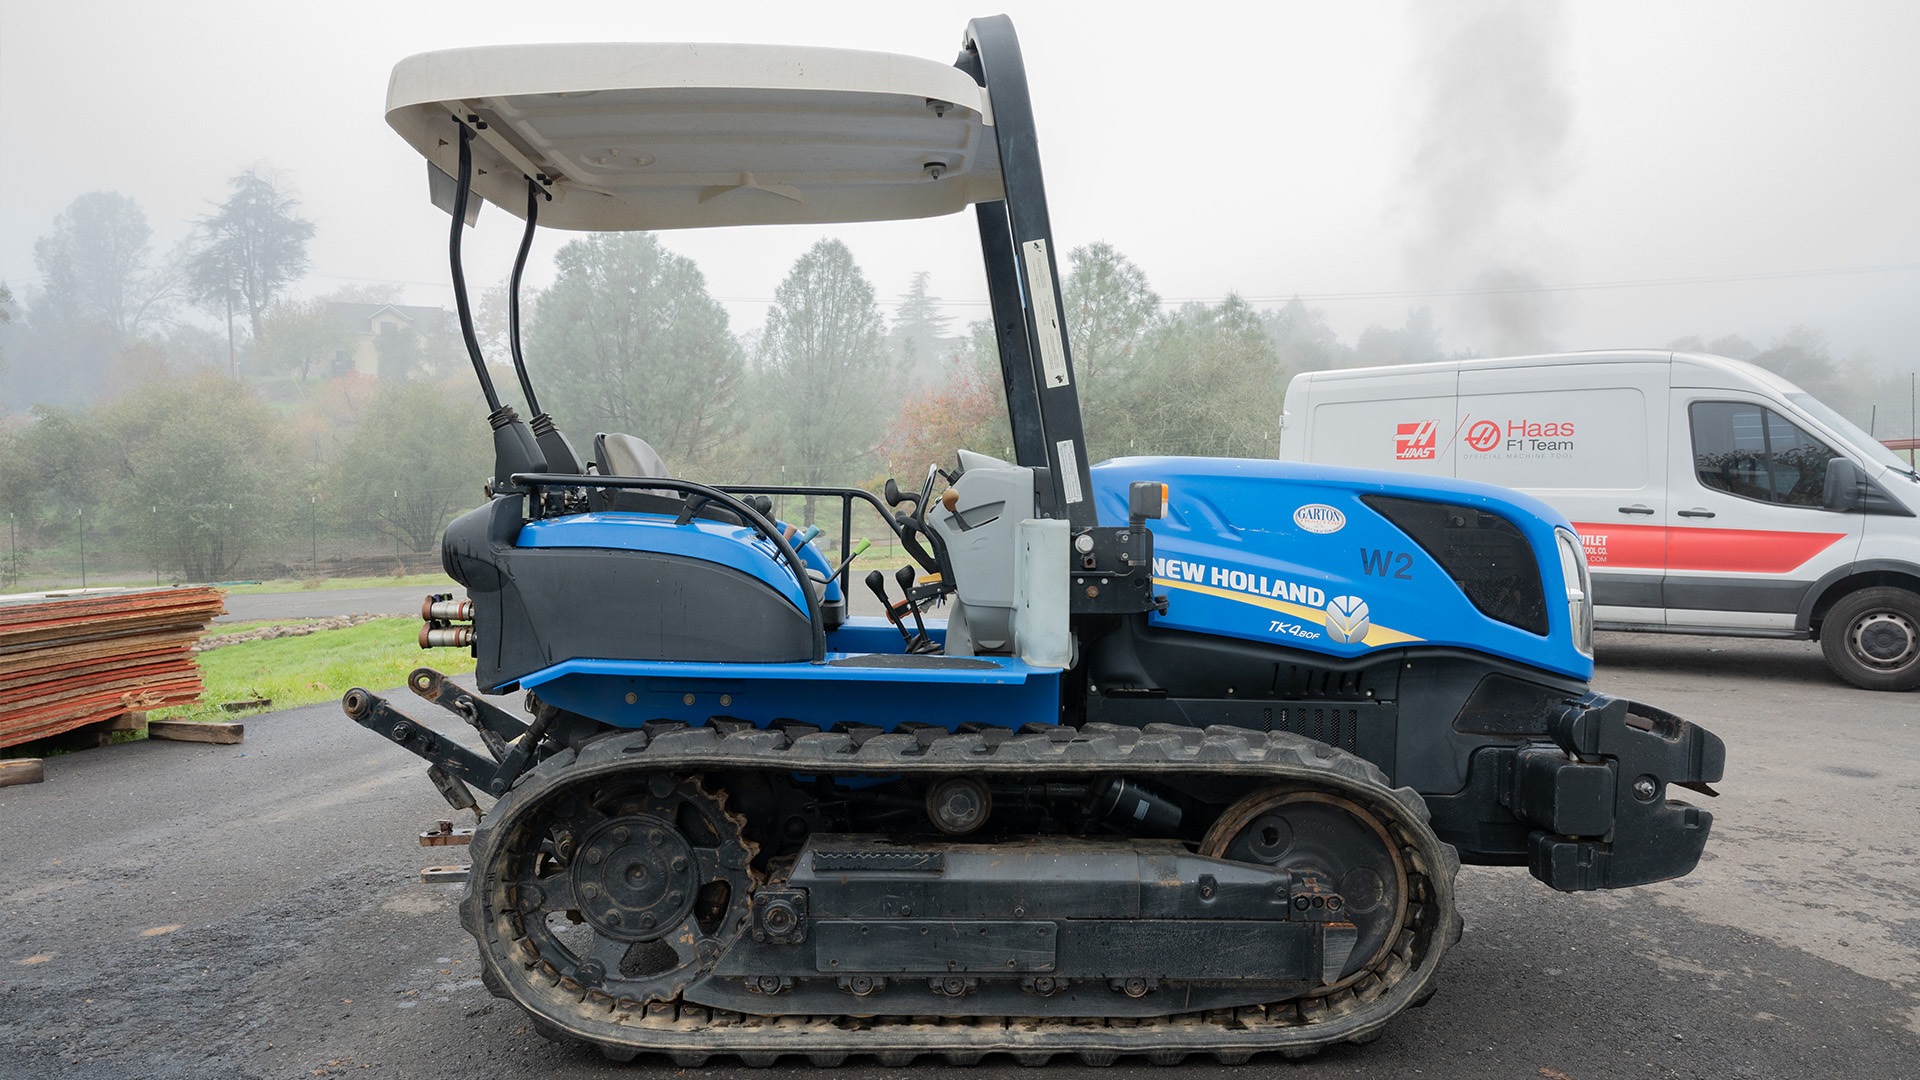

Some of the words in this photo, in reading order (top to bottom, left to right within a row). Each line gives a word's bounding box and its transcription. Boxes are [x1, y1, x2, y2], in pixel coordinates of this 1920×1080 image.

[1507, 419, 1575, 437] Haas
[1506, 439, 1523, 451] F1
[1528, 438, 1574, 451] Team
[1396, 447, 1436, 458] HAAS
[1297, 507, 1341, 522] GARTON
[1598, 546, 1608, 554] CO.
[1359, 546, 1414, 580] W2
[1152, 557, 1206, 583] NEW
[1211, 566, 1326, 608] HOLLAND
